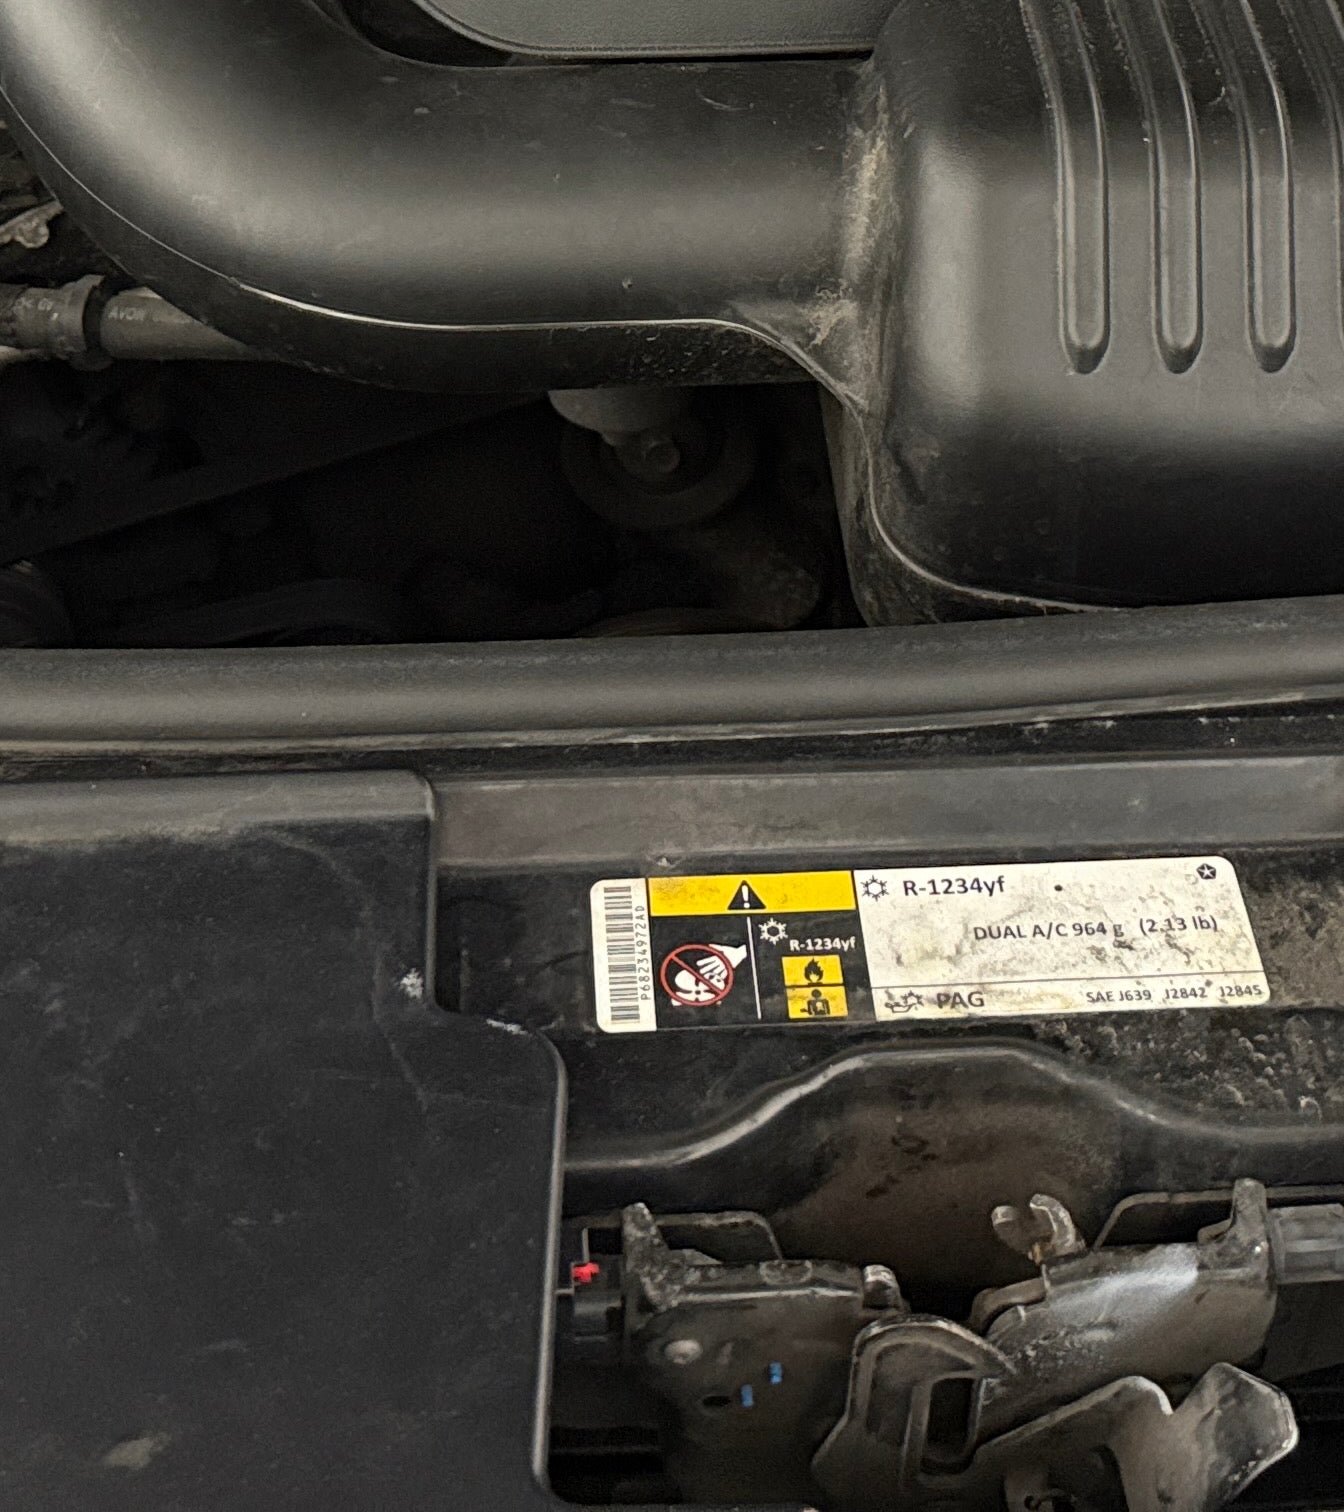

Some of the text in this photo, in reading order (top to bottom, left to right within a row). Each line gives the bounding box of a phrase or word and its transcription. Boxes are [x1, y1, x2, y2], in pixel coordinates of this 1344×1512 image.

[903, 875, 1005, 897] R-1234yf
[973, 914, 1218, 941] DUAL A/C 964 g (2.13 lb)
[635, 905, 652, 1001] P68234972AD
[789, 937, 856, 952] R-1234yf
[936, 990, 985, 1010] PAG
[1086, 984, 1263, 1004] SAE J639 J2842 J2845
